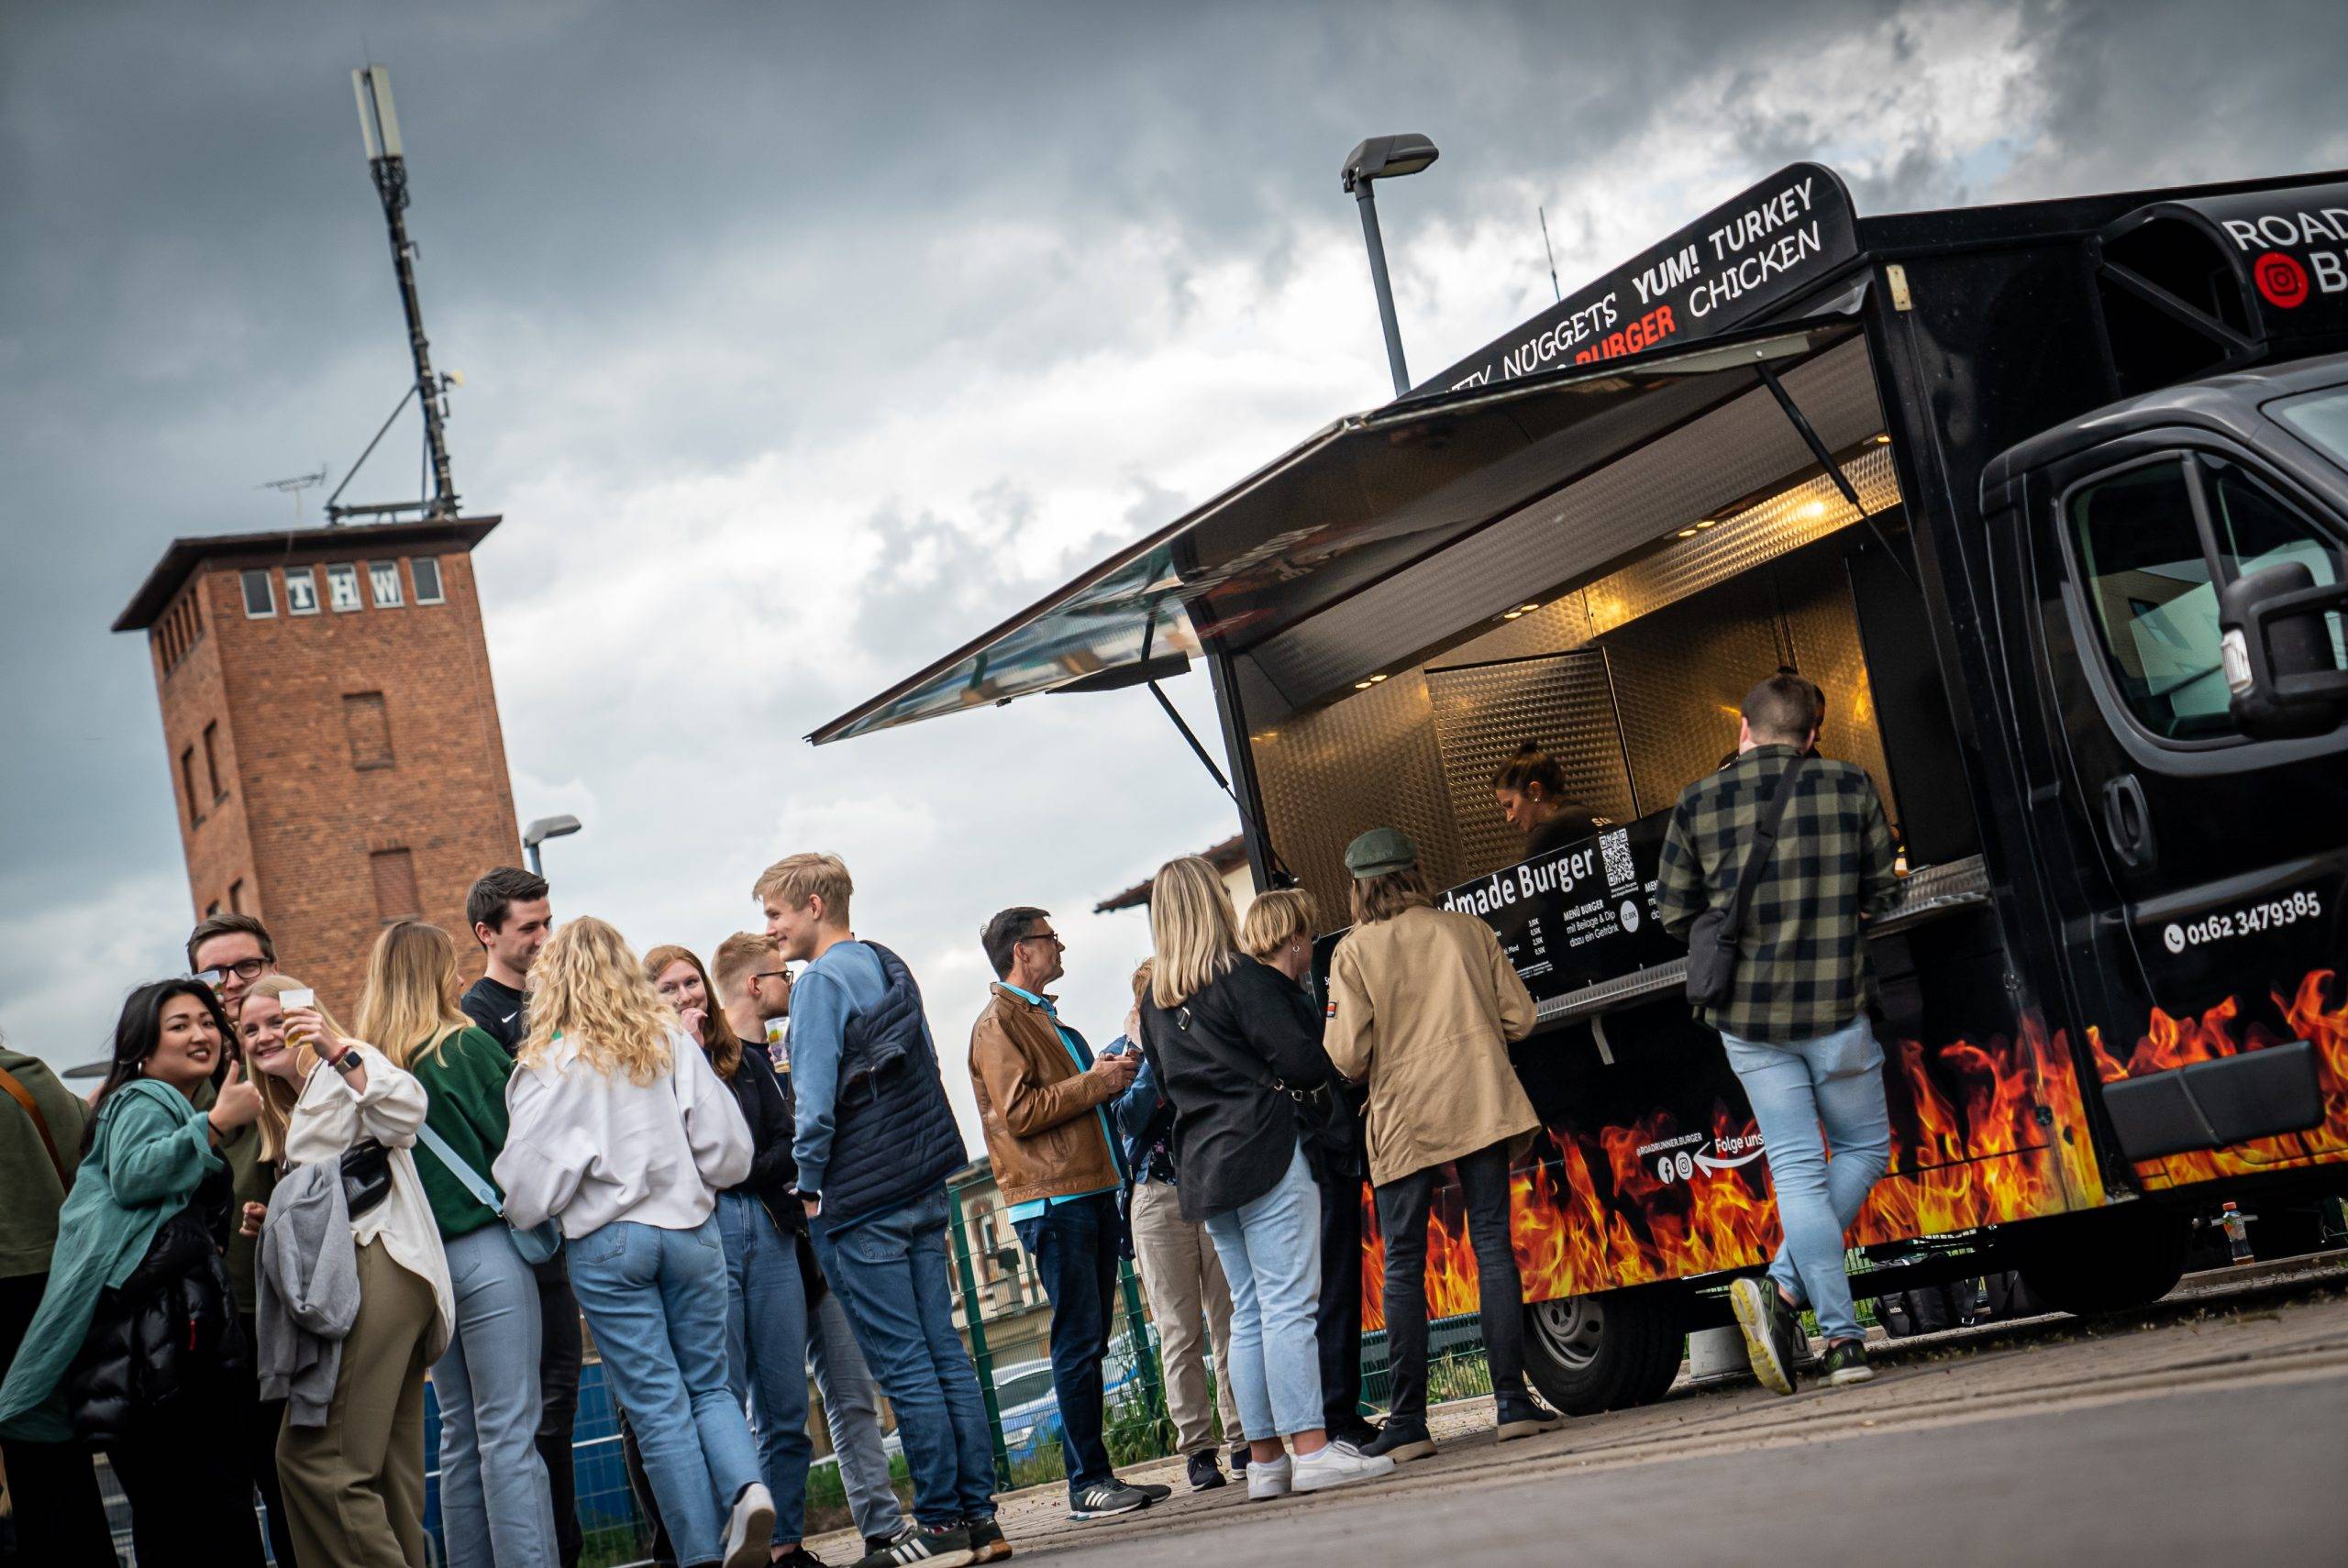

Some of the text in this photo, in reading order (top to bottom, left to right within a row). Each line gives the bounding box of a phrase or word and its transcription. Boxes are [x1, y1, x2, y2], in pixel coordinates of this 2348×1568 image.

[2221, 209, 2348, 250] ROAD
[1503, 292, 1617, 380] NUGGETS
[1632, 244, 1700, 304] YUM!
[1708, 177, 1812, 260] TURKEY
[1689, 220, 1821, 317] CHICKEN
[286, 570, 401, 607] THW
[1437, 848, 1593, 916] dmade Burger
[1576, 916, 1599, 931] Beilage
[1599, 913, 1605, 923] &
[1604, 910, 1616, 922] Dip
[1580, 899, 1604, 915] BURGER
[2187, 891, 2321, 945] 0162 3479385
[1569, 936, 1585, 947] dazu
[1585, 932, 1595, 942] ein
[1714, 1132, 1764, 1154] Folge uns
